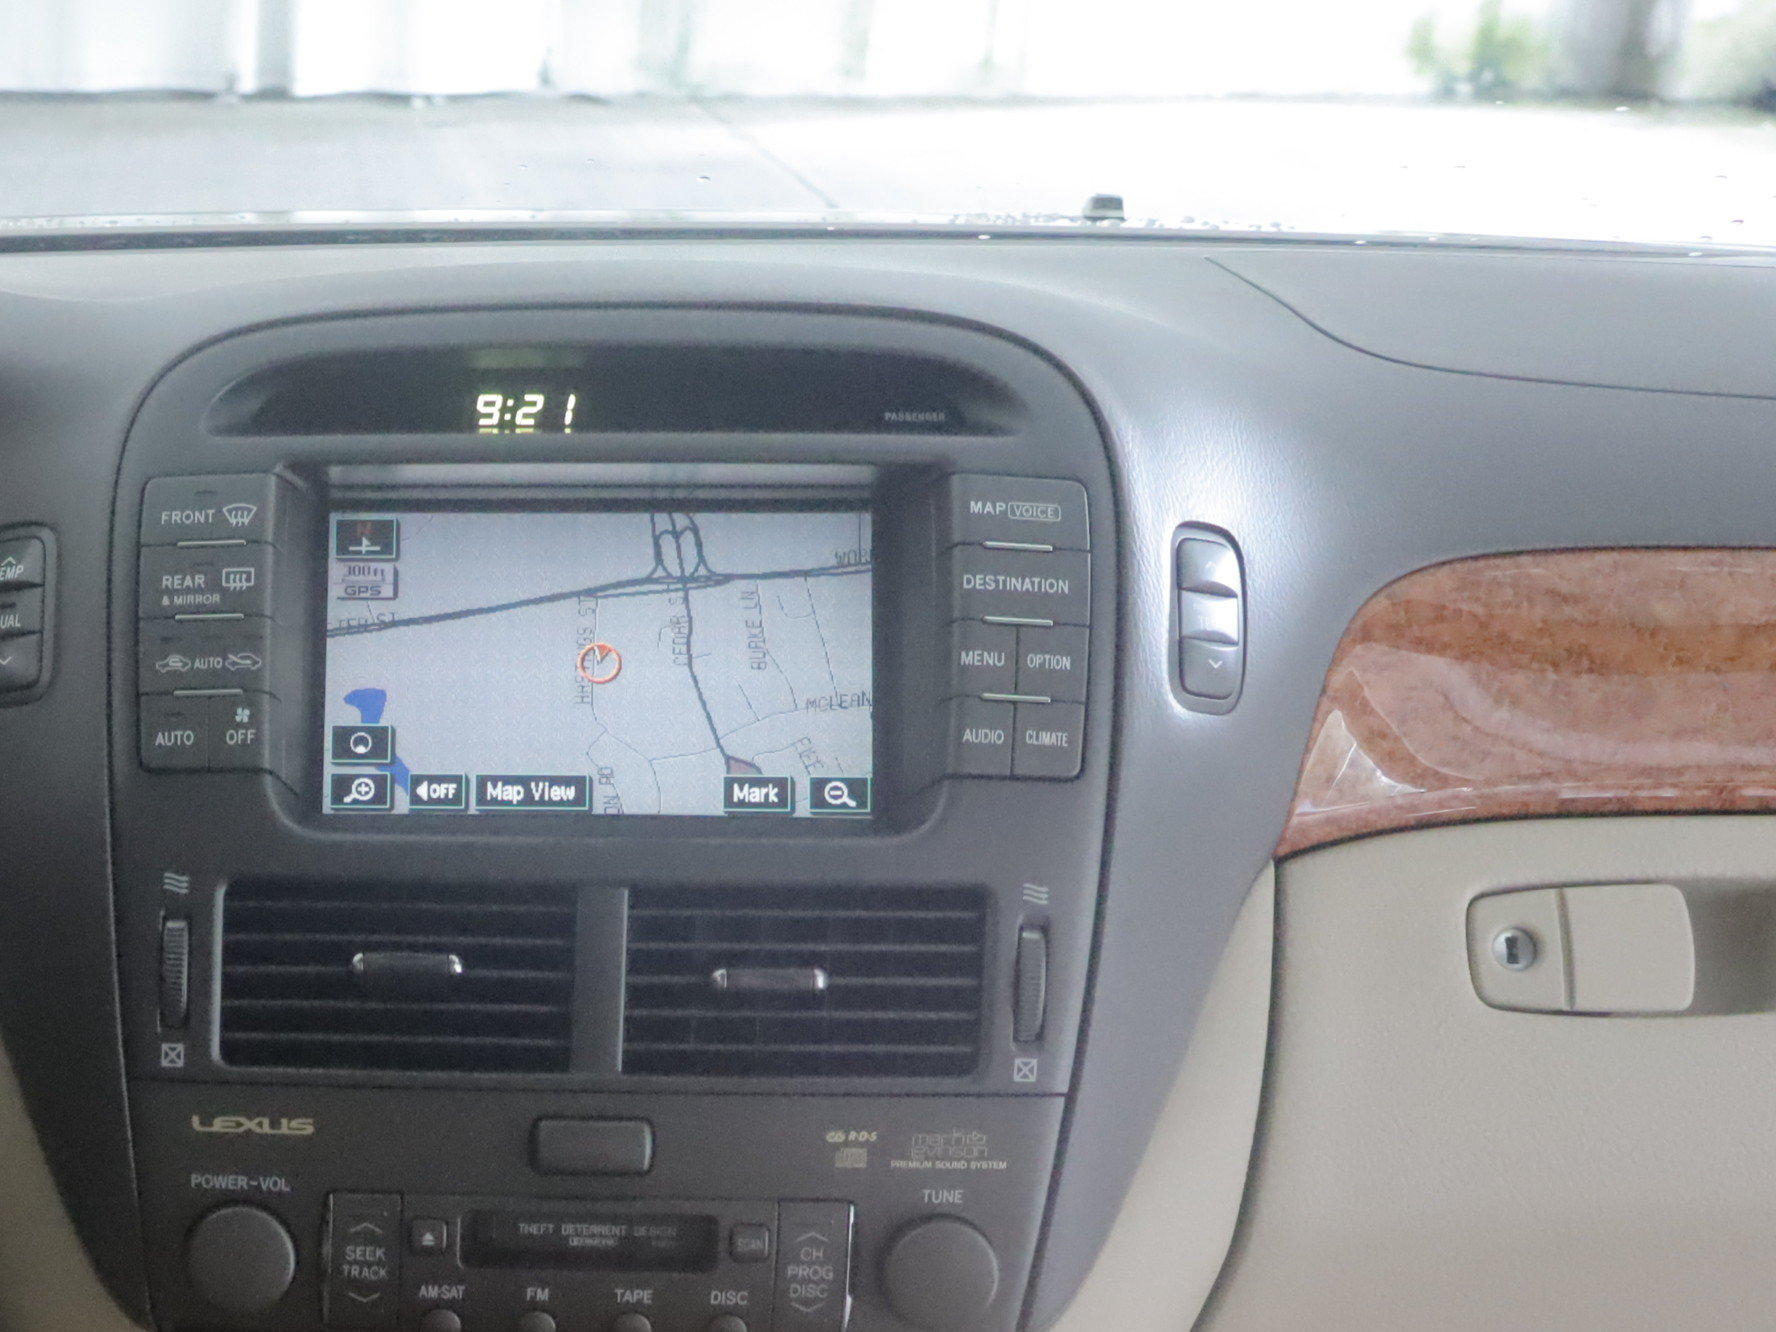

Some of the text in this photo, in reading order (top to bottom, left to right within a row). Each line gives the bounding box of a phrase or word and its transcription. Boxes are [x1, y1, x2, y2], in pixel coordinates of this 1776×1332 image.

[476, 393, 576, 426] 9:21
[160, 508, 215, 525] FRONT
[969, 500, 1056, 519] MAP VOICE
[161, 574, 206, 589] REAR
[962, 574, 1070, 595] DESTINATION
[343, 584, 382, 597] GPS
[173, 593, 221, 606] MIRROR
[193, 656, 223, 670] AUTO
[960, 651, 1005, 667] MENU
[1027, 654, 1071, 670] OPTION
[155, 730, 194, 746] AUTO
[225, 729, 256, 746] OFF
[962, 729, 1004, 745] AUDIO
[1025, 730, 1068, 747] CLIMATE
[429, 783, 457, 799] OFF
[486, 782, 576, 801] Map View
[732, 784, 779, 803] Mark
[190, 1114, 315, 1136] LEXUS
[890, 1159, 1008, 1170] PREMIUM SOUND SYSTEM
[190, 1173, 291, 1193] POWER-VOL
[921, 1189, 965, 1205] TUNE
[518, 1223, 556, 1236] THEFT
[344, 1245, 386, 1261] SEEK
[800, 1247, 824, 1261] CH
[341, 1264, 389, 1281] TRACK
[786, 1265, 834, 1280] PROG
[526, 1287, 549, 1302] FM
[614, 1289, 654, 1304] TAPE
[710, 1290, 749, 1306] DISC
[789, 1283, 829, 1299] DISC
